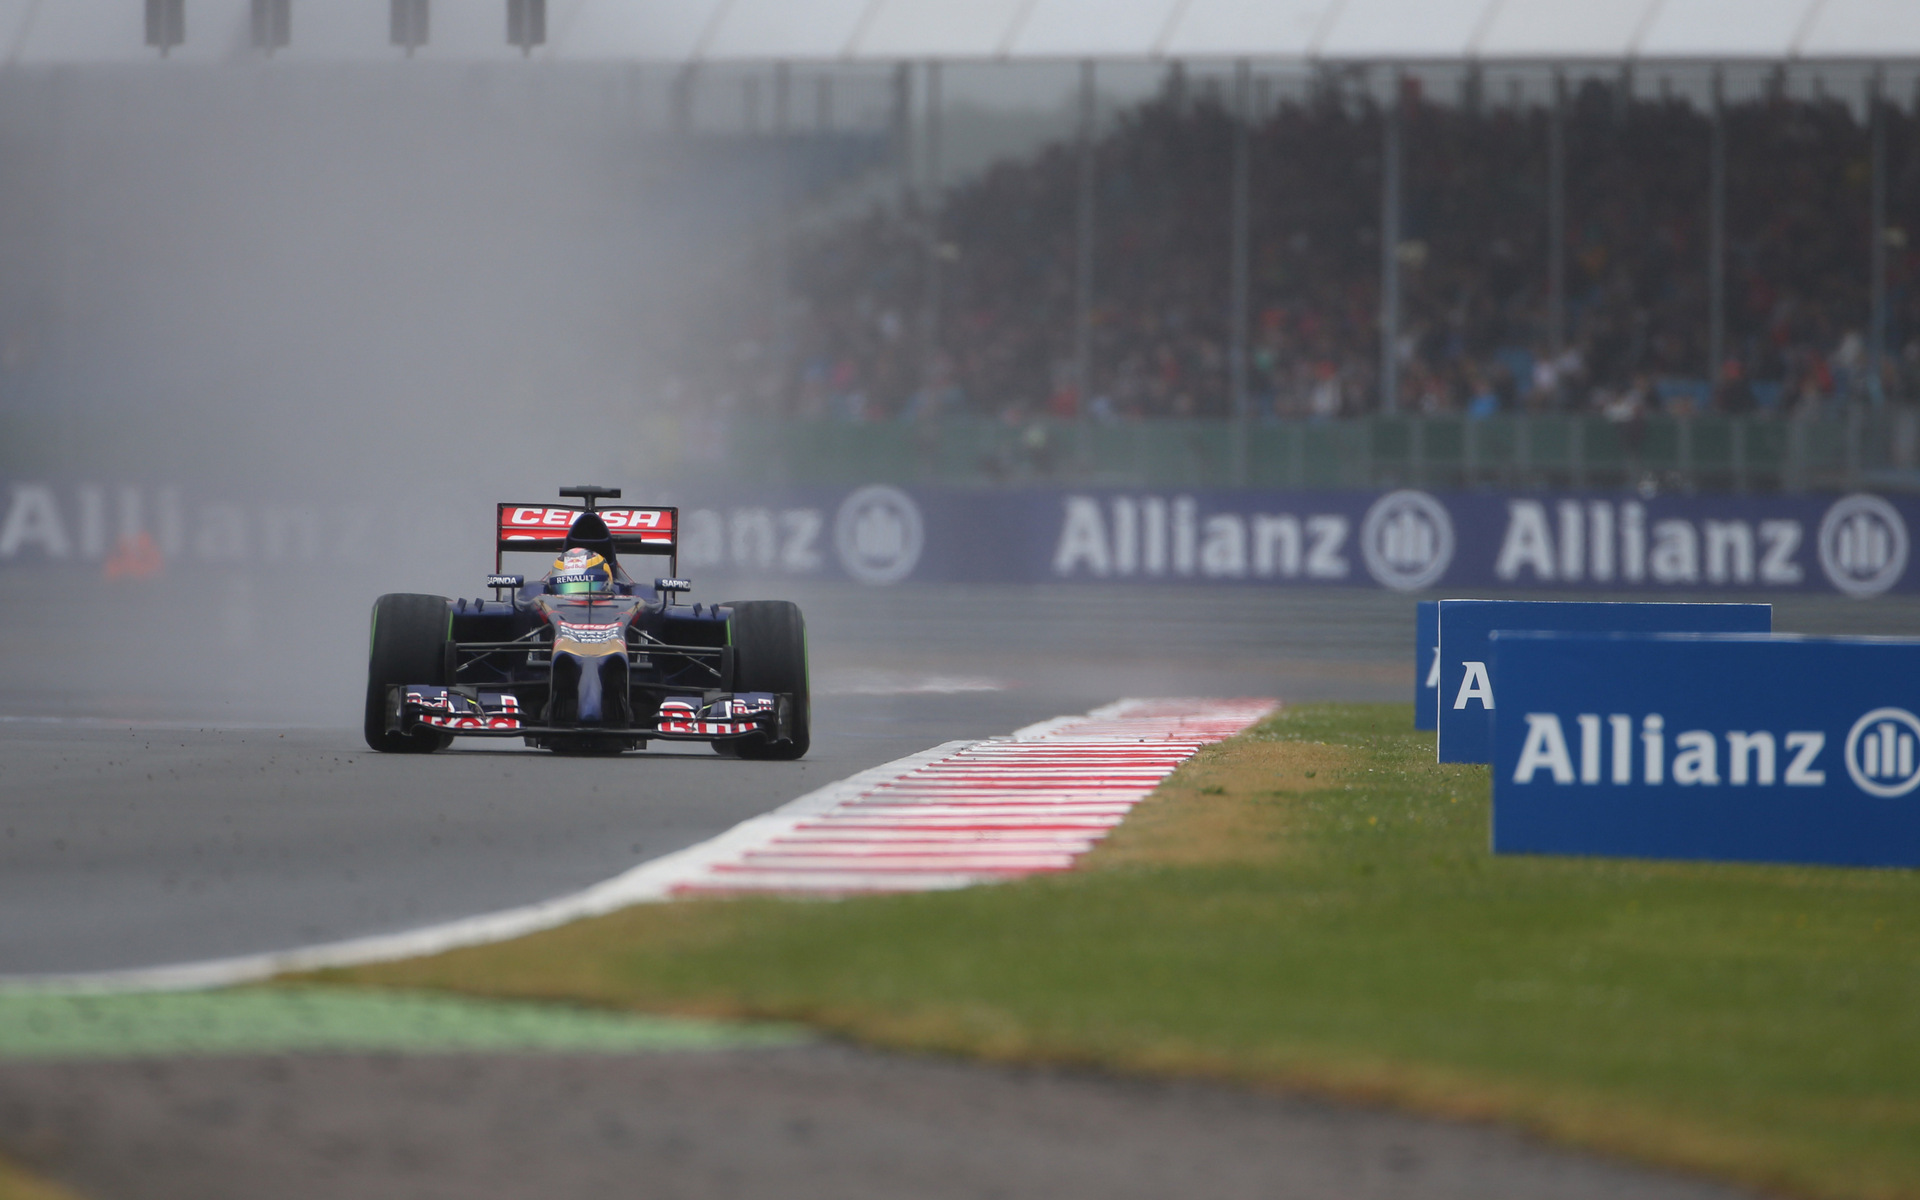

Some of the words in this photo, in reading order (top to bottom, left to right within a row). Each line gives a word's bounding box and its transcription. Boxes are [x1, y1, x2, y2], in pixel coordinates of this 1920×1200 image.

[511, 507, 661, 528] CESA
[1053, 496, 1350, 577] Allianz
[1497, 499, 1803, 582] Allianz
[556, 574, 595, 584] RENAULT
[1512, 713, 1826, 786] Allianz
